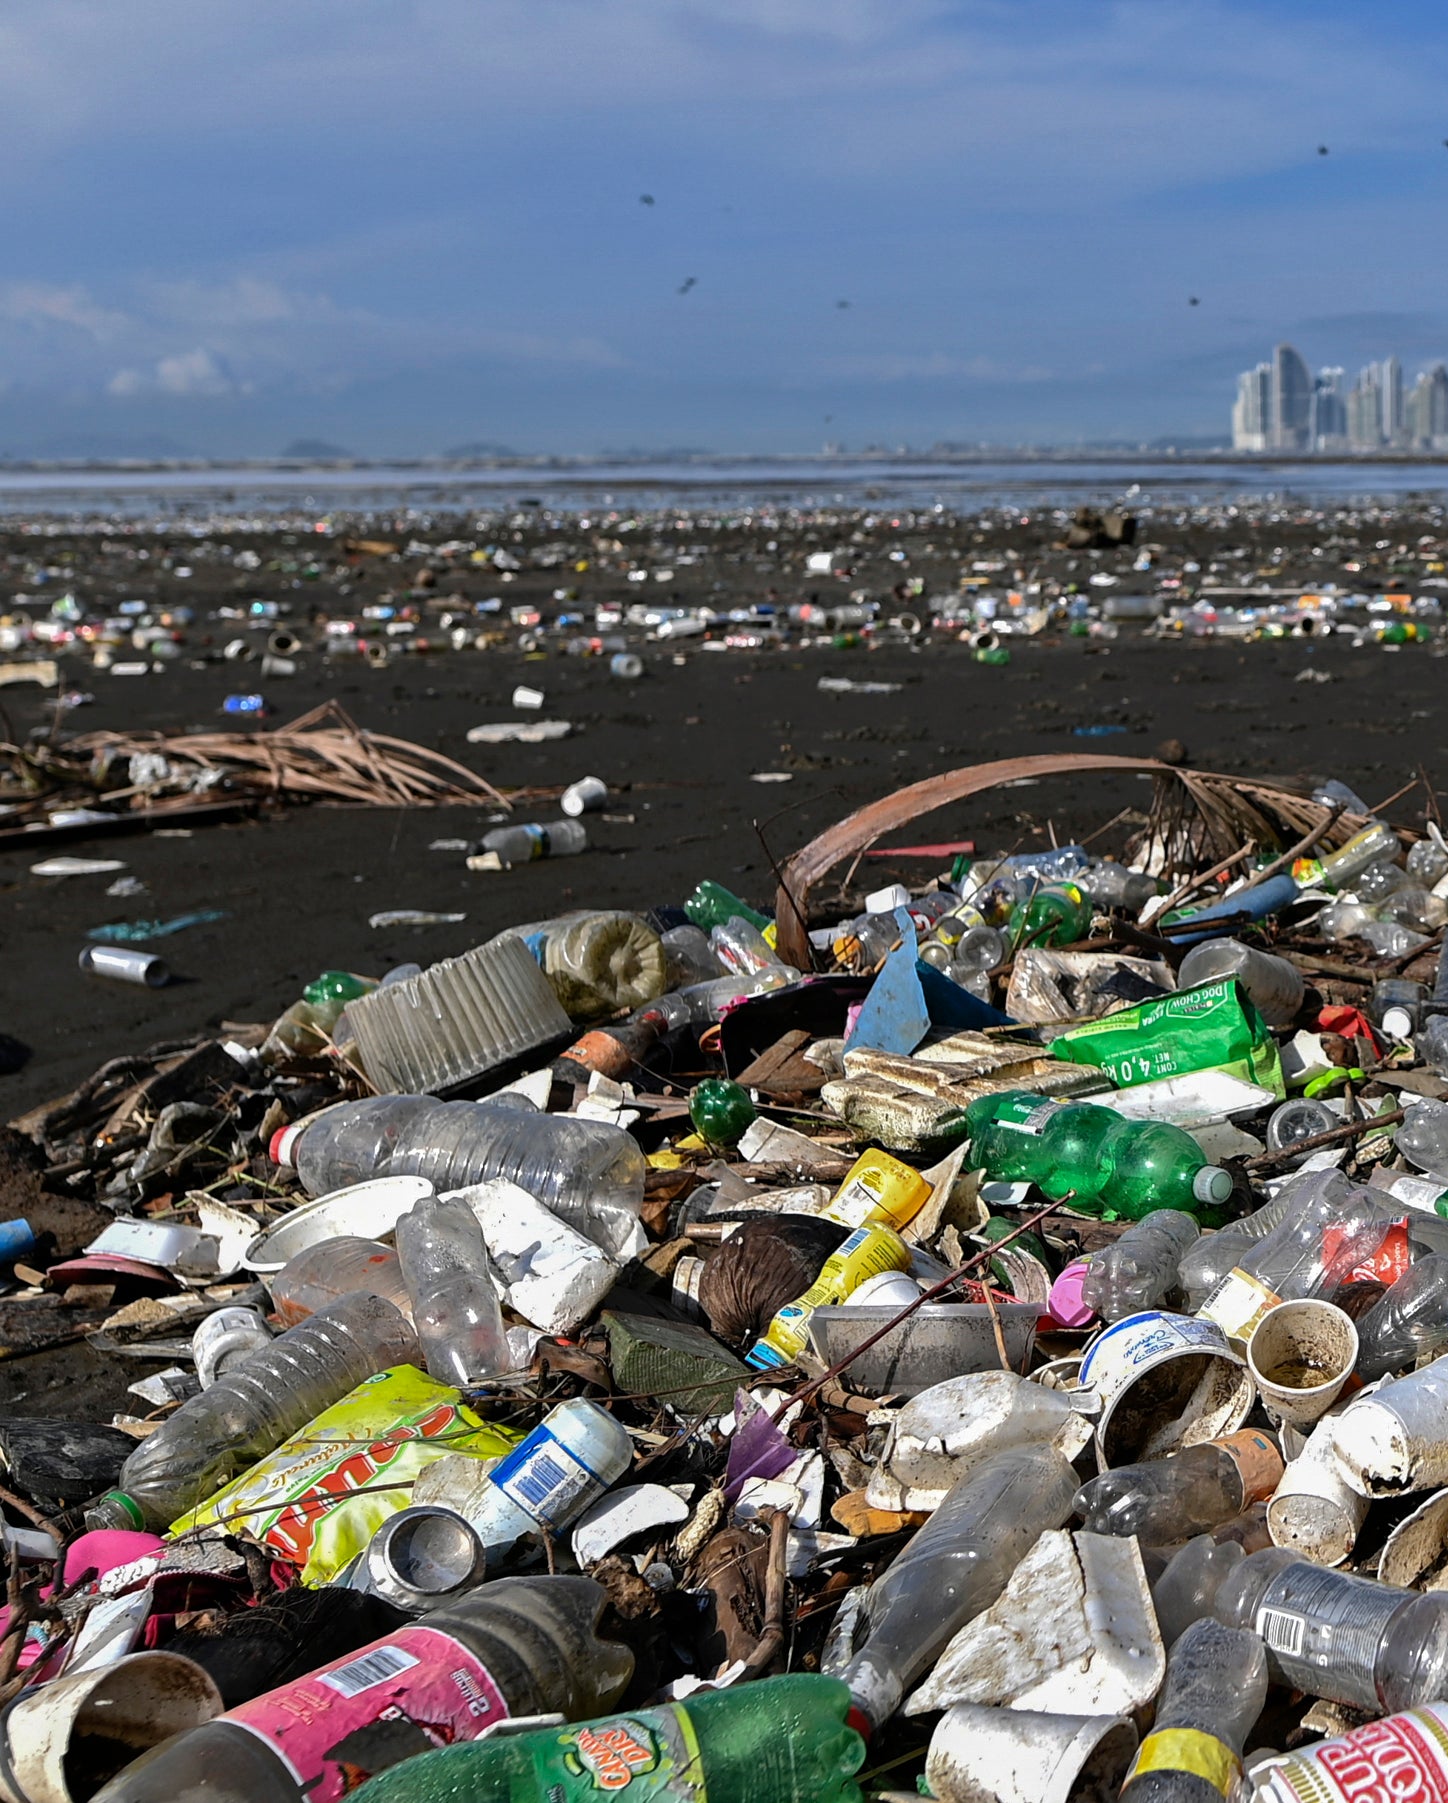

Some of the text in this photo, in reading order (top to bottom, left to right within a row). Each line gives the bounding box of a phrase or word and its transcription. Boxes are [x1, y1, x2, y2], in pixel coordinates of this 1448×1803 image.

[1171, 990, 1200, 1010] CHOW
[1199, 984, 1224, 999] DOG
[1154, 1051, 1170, 1062] NET.
[1156, 1061, 1177, 1075] CONT.
[596, 1728, 653, 1765] DRY
[575, 1726, 632, 1792] CANADA
